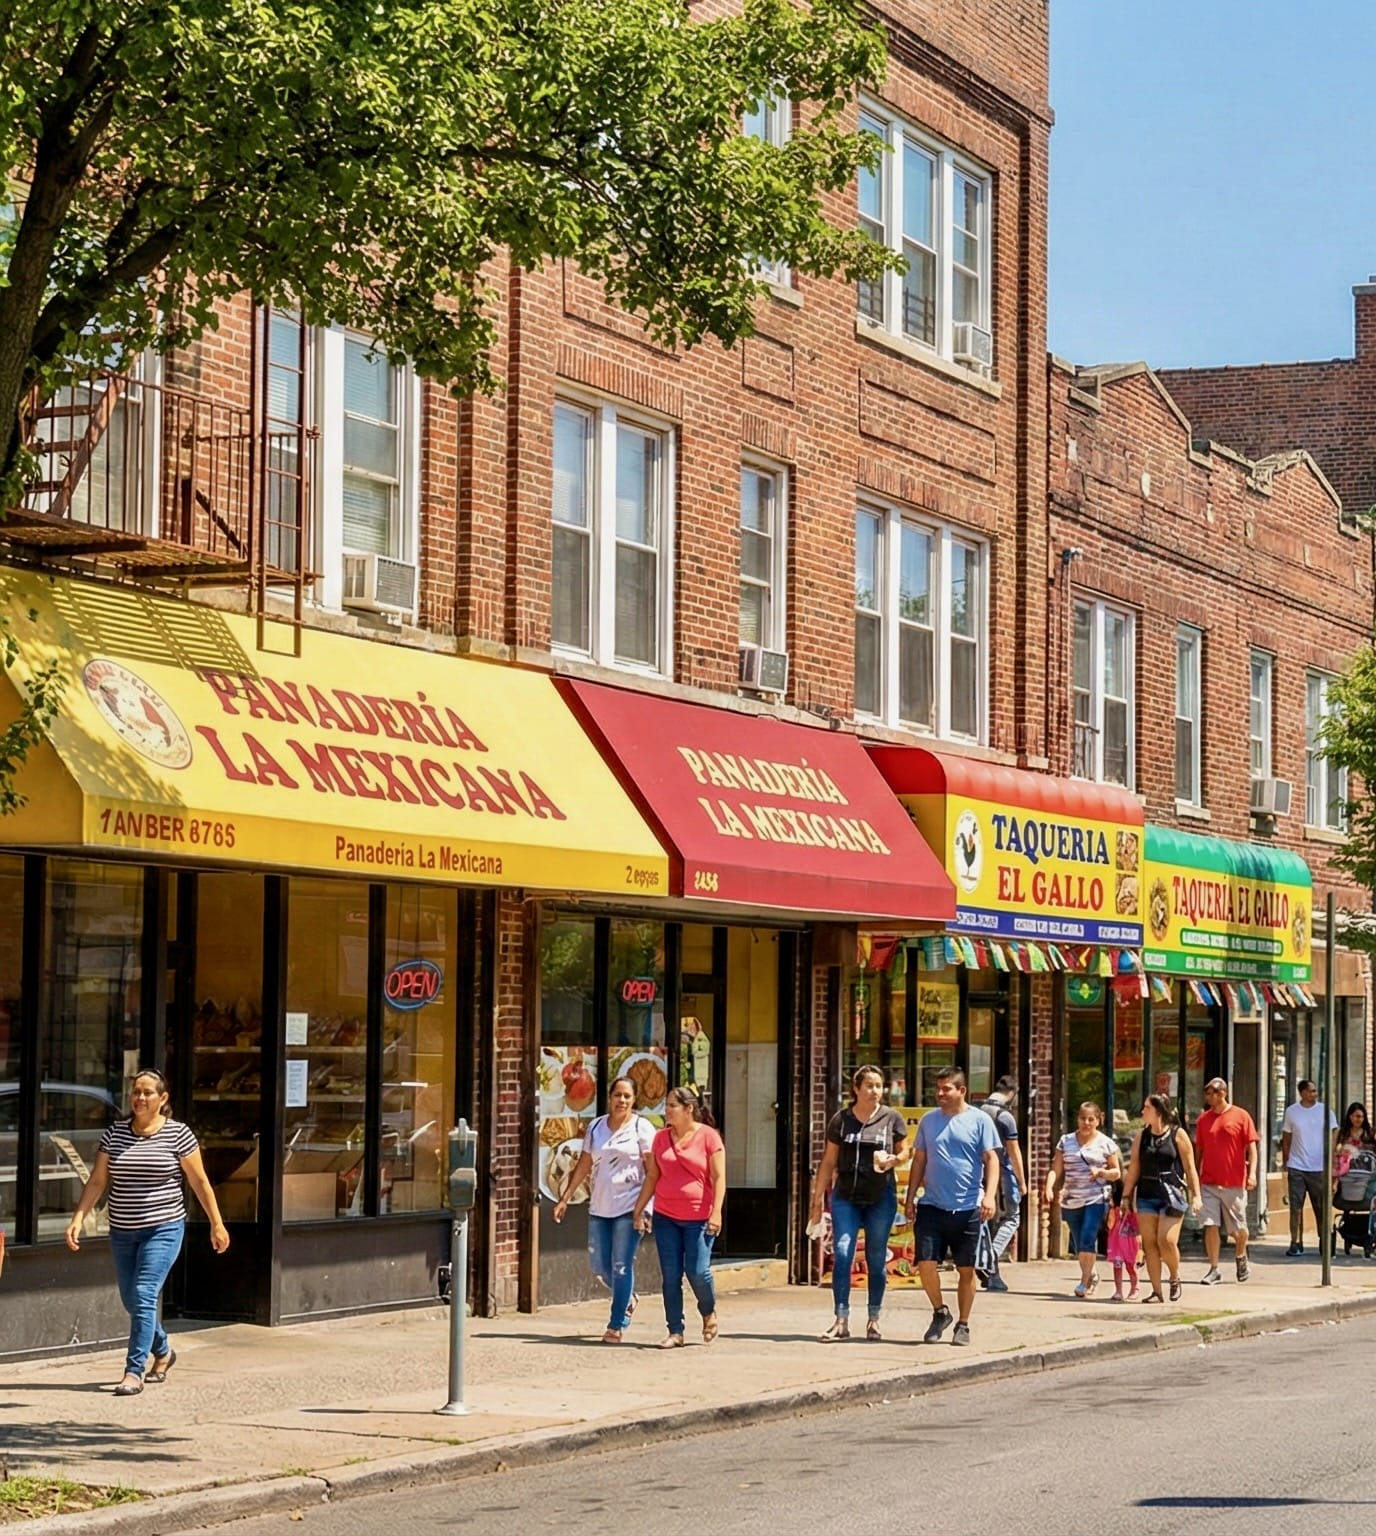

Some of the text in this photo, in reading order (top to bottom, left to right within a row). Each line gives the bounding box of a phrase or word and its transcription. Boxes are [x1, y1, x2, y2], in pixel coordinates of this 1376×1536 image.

[203, 671, 488, 752] PANADERÍA
[195, 725, 567, 821] LA MEXICANA
[677, 746, 849, 806] PANADERÍA
[697, 797, 891, 855] LA MEXICANA
[992, 814, 1110, 865] TAQUERIA
[419, 844, 435, 868] La
[440, 846, 503, 874] Mexicana
[998, 866, 1104, 911] EL GALLO
[1239, 887, 1250, 925] EL
[1254, 889, 1288, 929] GALLO
[387, 971, 437, 998] OPEN
[622, 980, 656, 1002] OPEN
